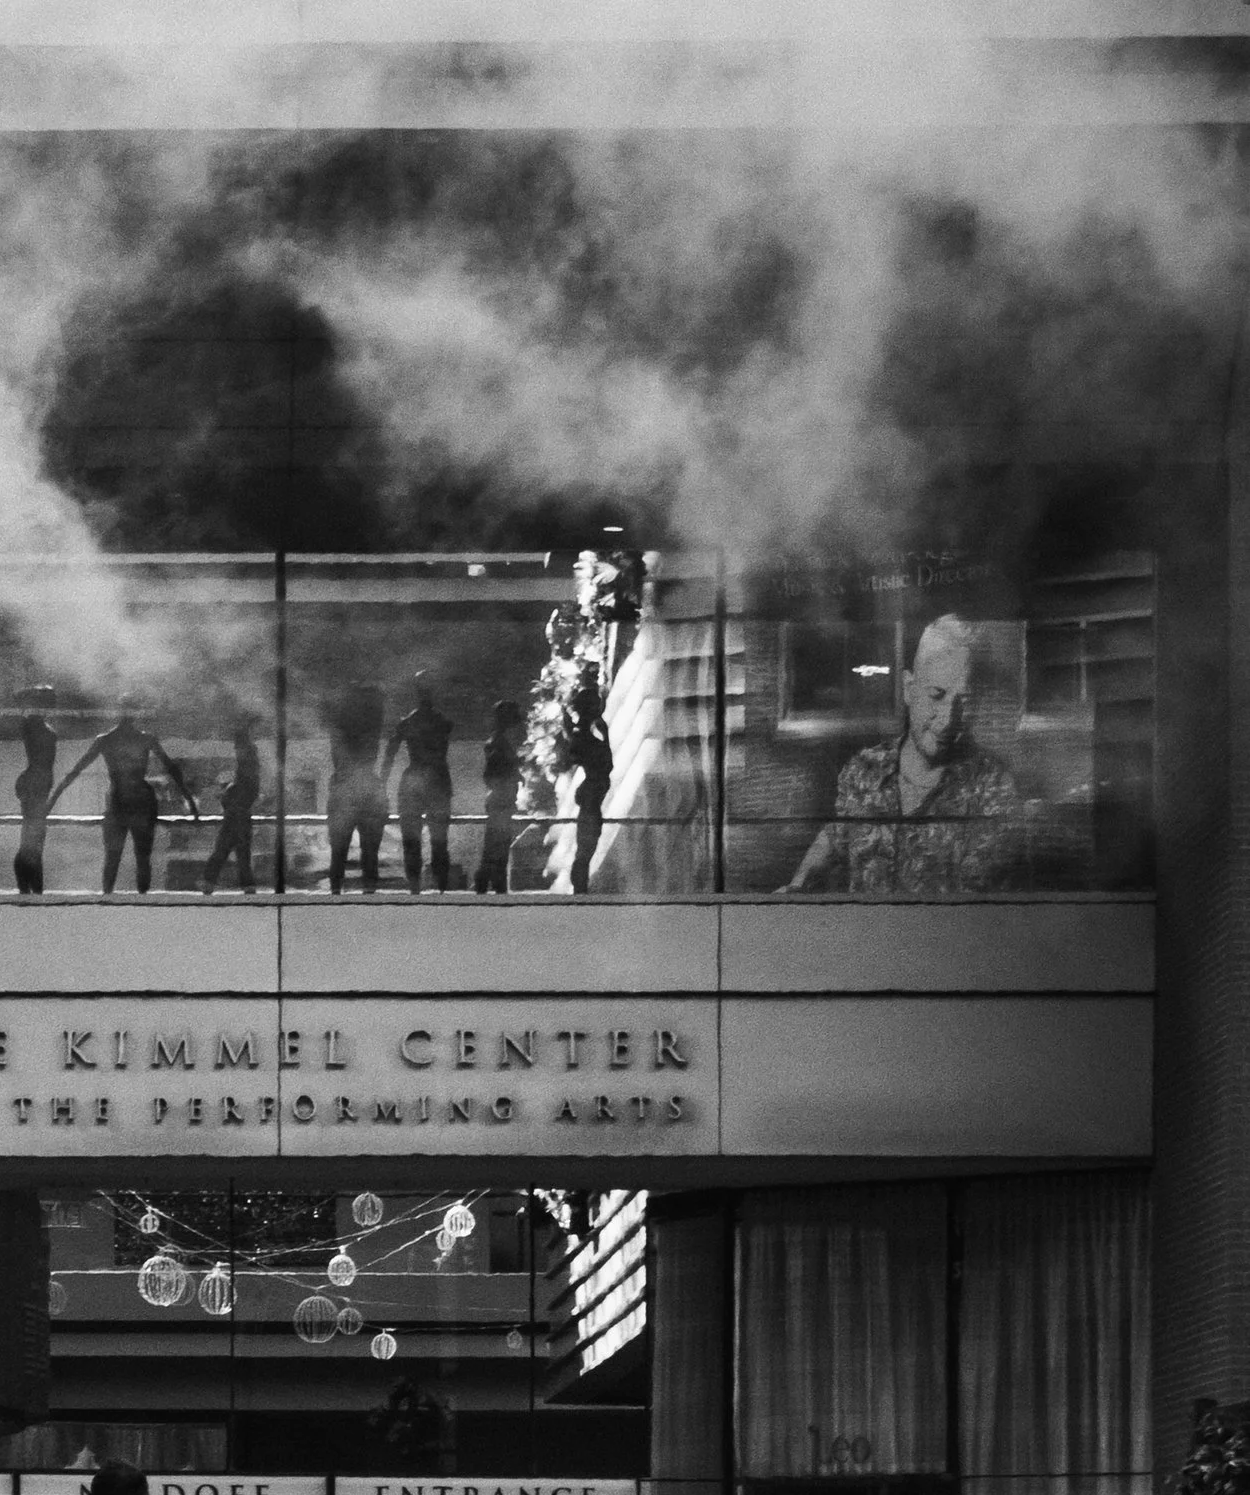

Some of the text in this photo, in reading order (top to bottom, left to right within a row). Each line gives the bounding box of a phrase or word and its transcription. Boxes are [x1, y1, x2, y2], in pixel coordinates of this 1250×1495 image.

[61, 1028, 347, 1070] KIMMEL
[399, 1029, 690, 1070] CENTER
[12, 1096, 111, 1125] THE
[154, 1096, 516, 1125] PERFORMING
[555, 1096, 685, 1125] ARTS
